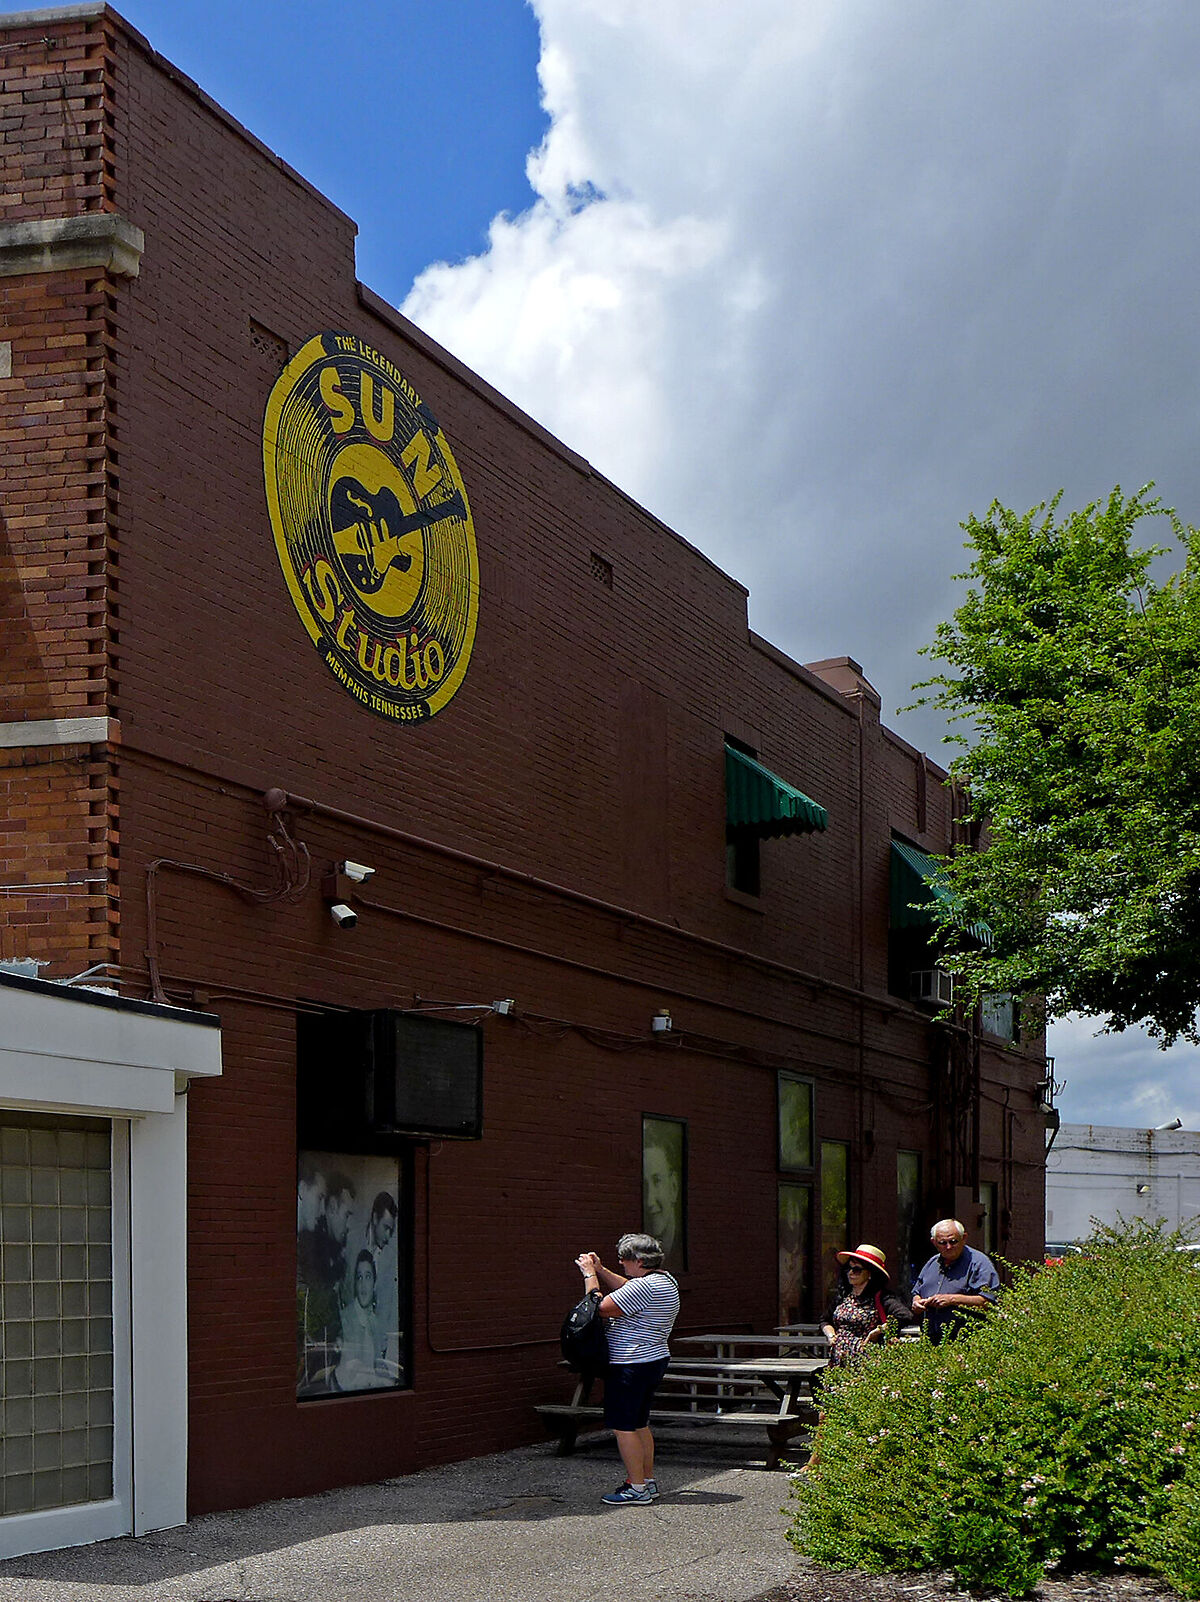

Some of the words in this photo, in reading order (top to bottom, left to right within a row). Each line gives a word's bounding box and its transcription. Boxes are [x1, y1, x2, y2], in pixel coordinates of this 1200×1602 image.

[335, 335, 357, 352] THE
[359, 340, 423, 408] LEGENDARY
[319, 365, 444, 500] SUN
[303, 559, 445, 690] Studio
[371, 694, 424, 720] TENNESSEE
